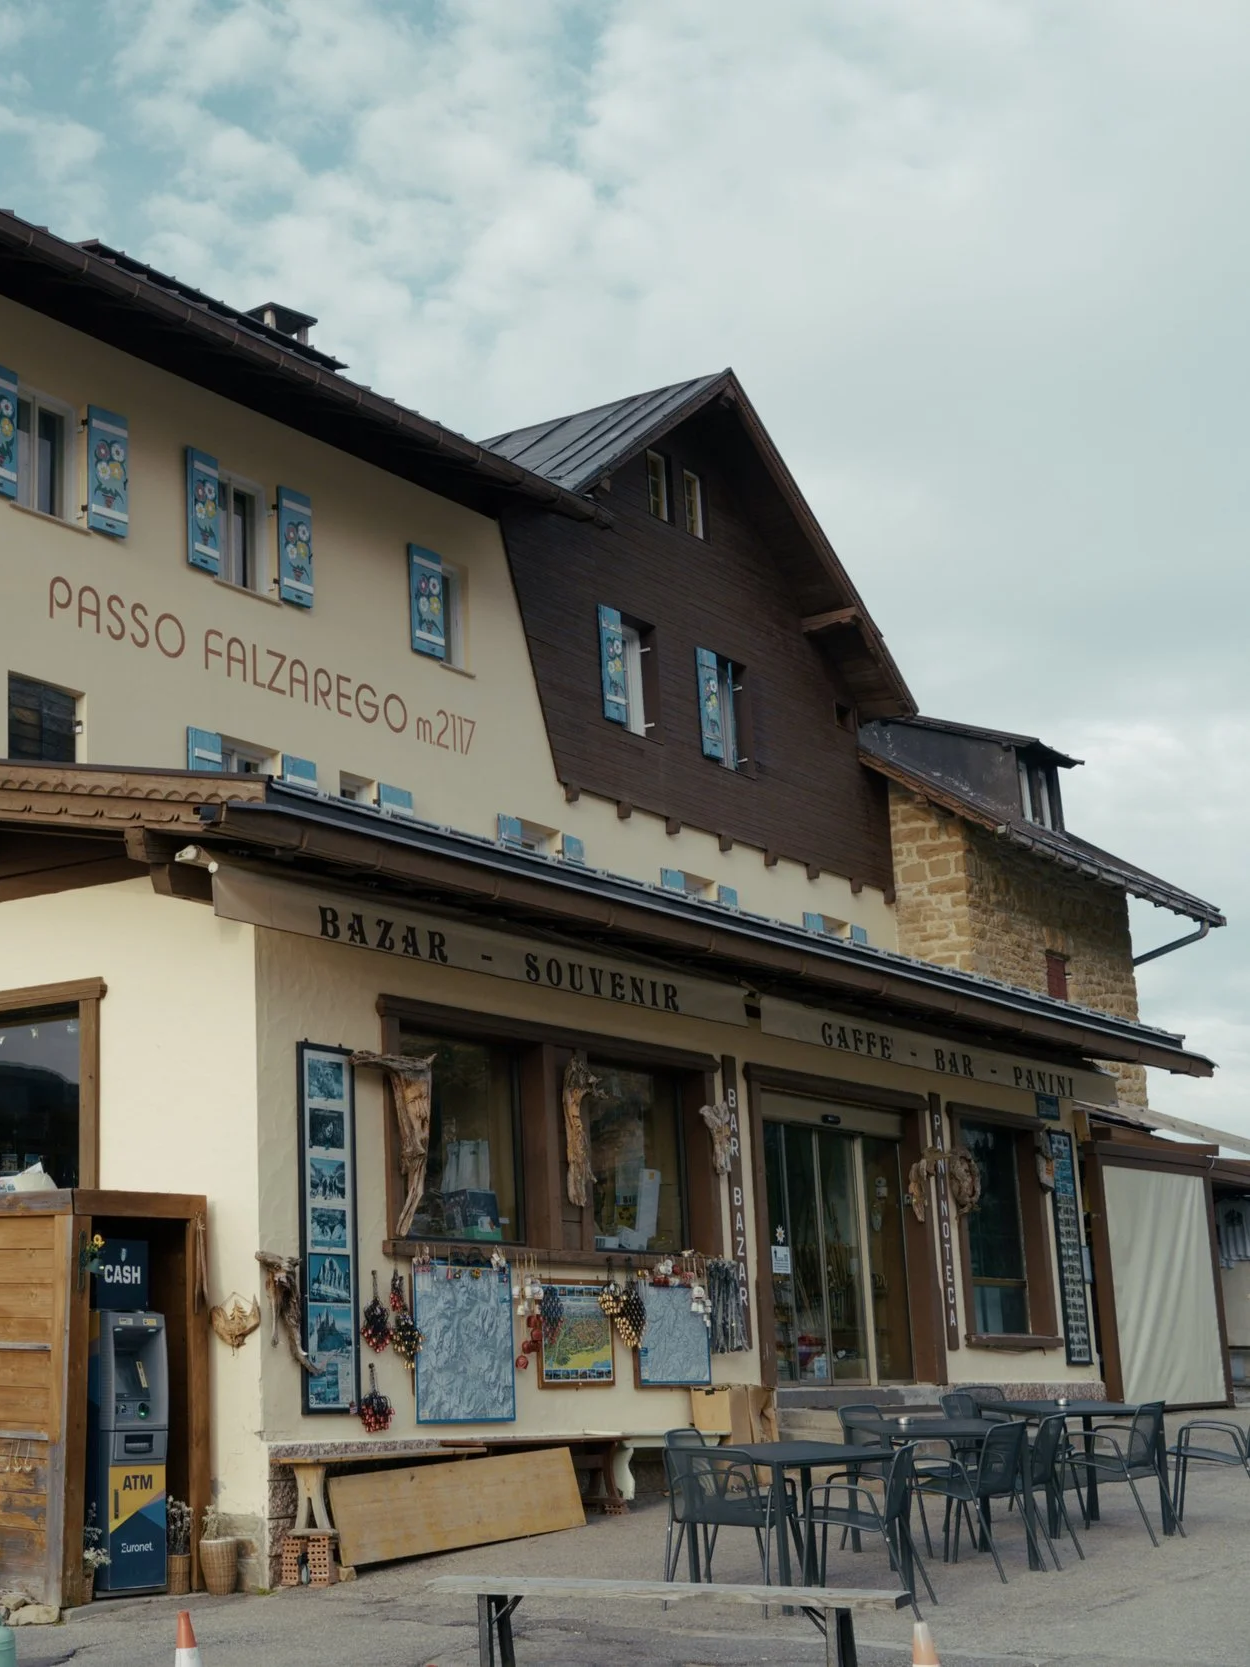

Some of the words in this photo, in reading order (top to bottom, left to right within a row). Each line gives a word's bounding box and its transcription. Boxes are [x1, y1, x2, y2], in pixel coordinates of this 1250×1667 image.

[49, 575, 186, 659] PASSO
[204, 628, 408, 734] FALZAREGO
[318, 905, 449, 964] BAZAR
[525, 952, 680, 1012] SOUVENIR
[934, 1048, 974, 1078] BAR
[1013, 1066, 1075, 1098] PANINI
[727, 1088, 740, 1157] BAR
[733, 1187, 748, 1307] BAZAR
[934, 1114, 957, 1327] PANINOTECA
[104, 1264, 141, 1285] CASH
[122, 1474, 153, 1491] ATM
